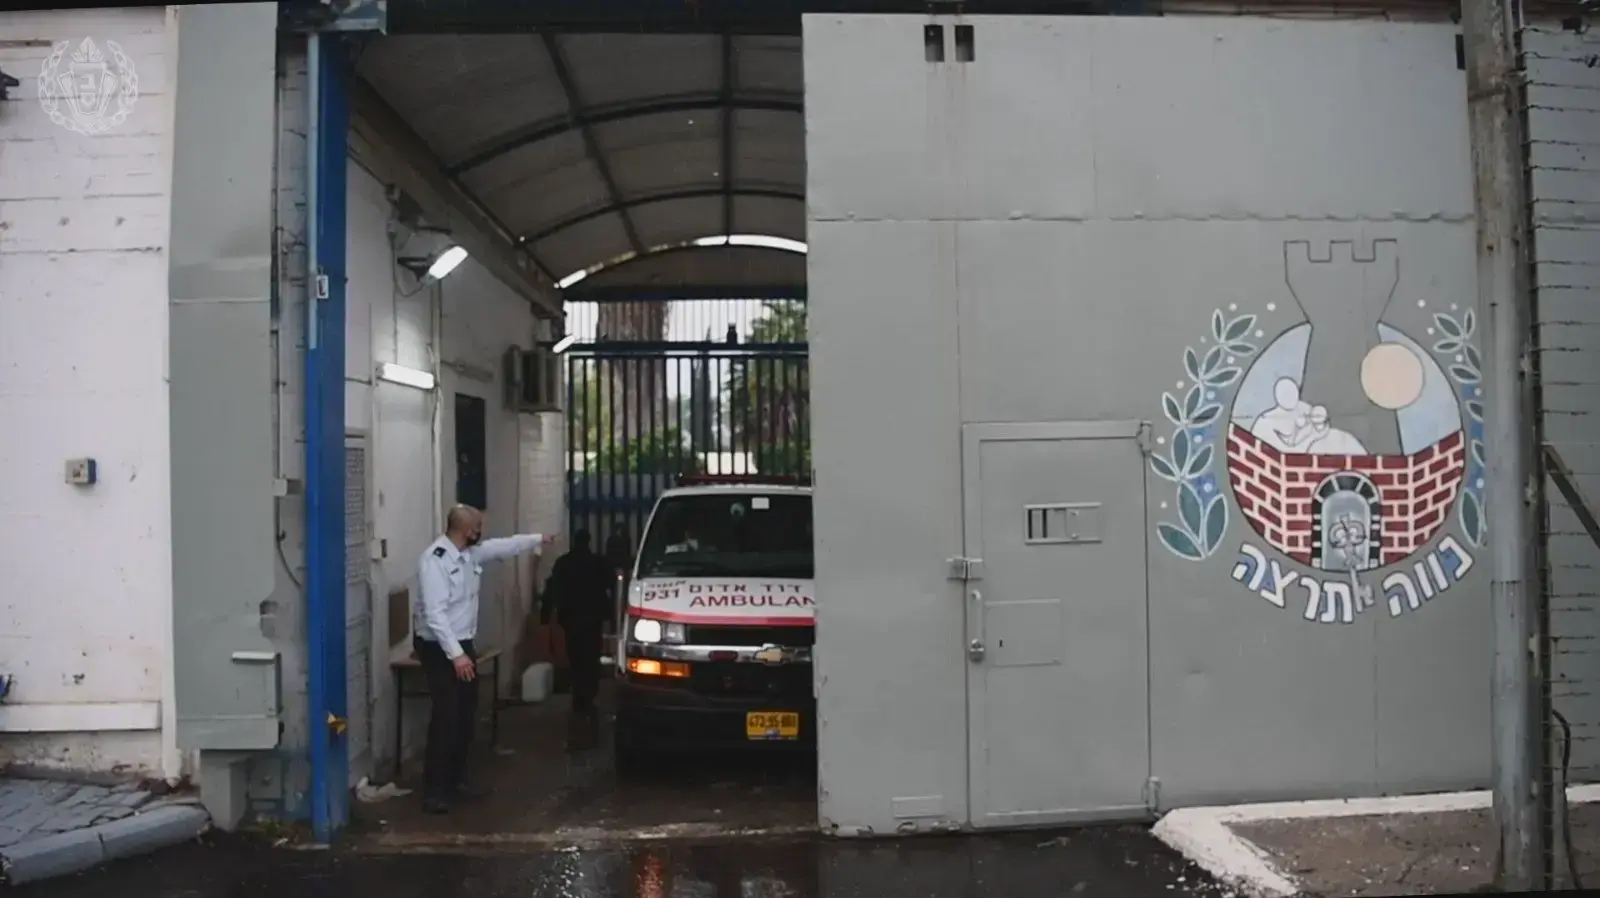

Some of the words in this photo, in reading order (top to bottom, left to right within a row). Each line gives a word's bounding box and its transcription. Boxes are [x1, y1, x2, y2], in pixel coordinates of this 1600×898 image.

[644, 588, 680, 602] 931
[1231, 543, 1353, 623] תרצה
[1381, 534, 1474, 616] נווה
